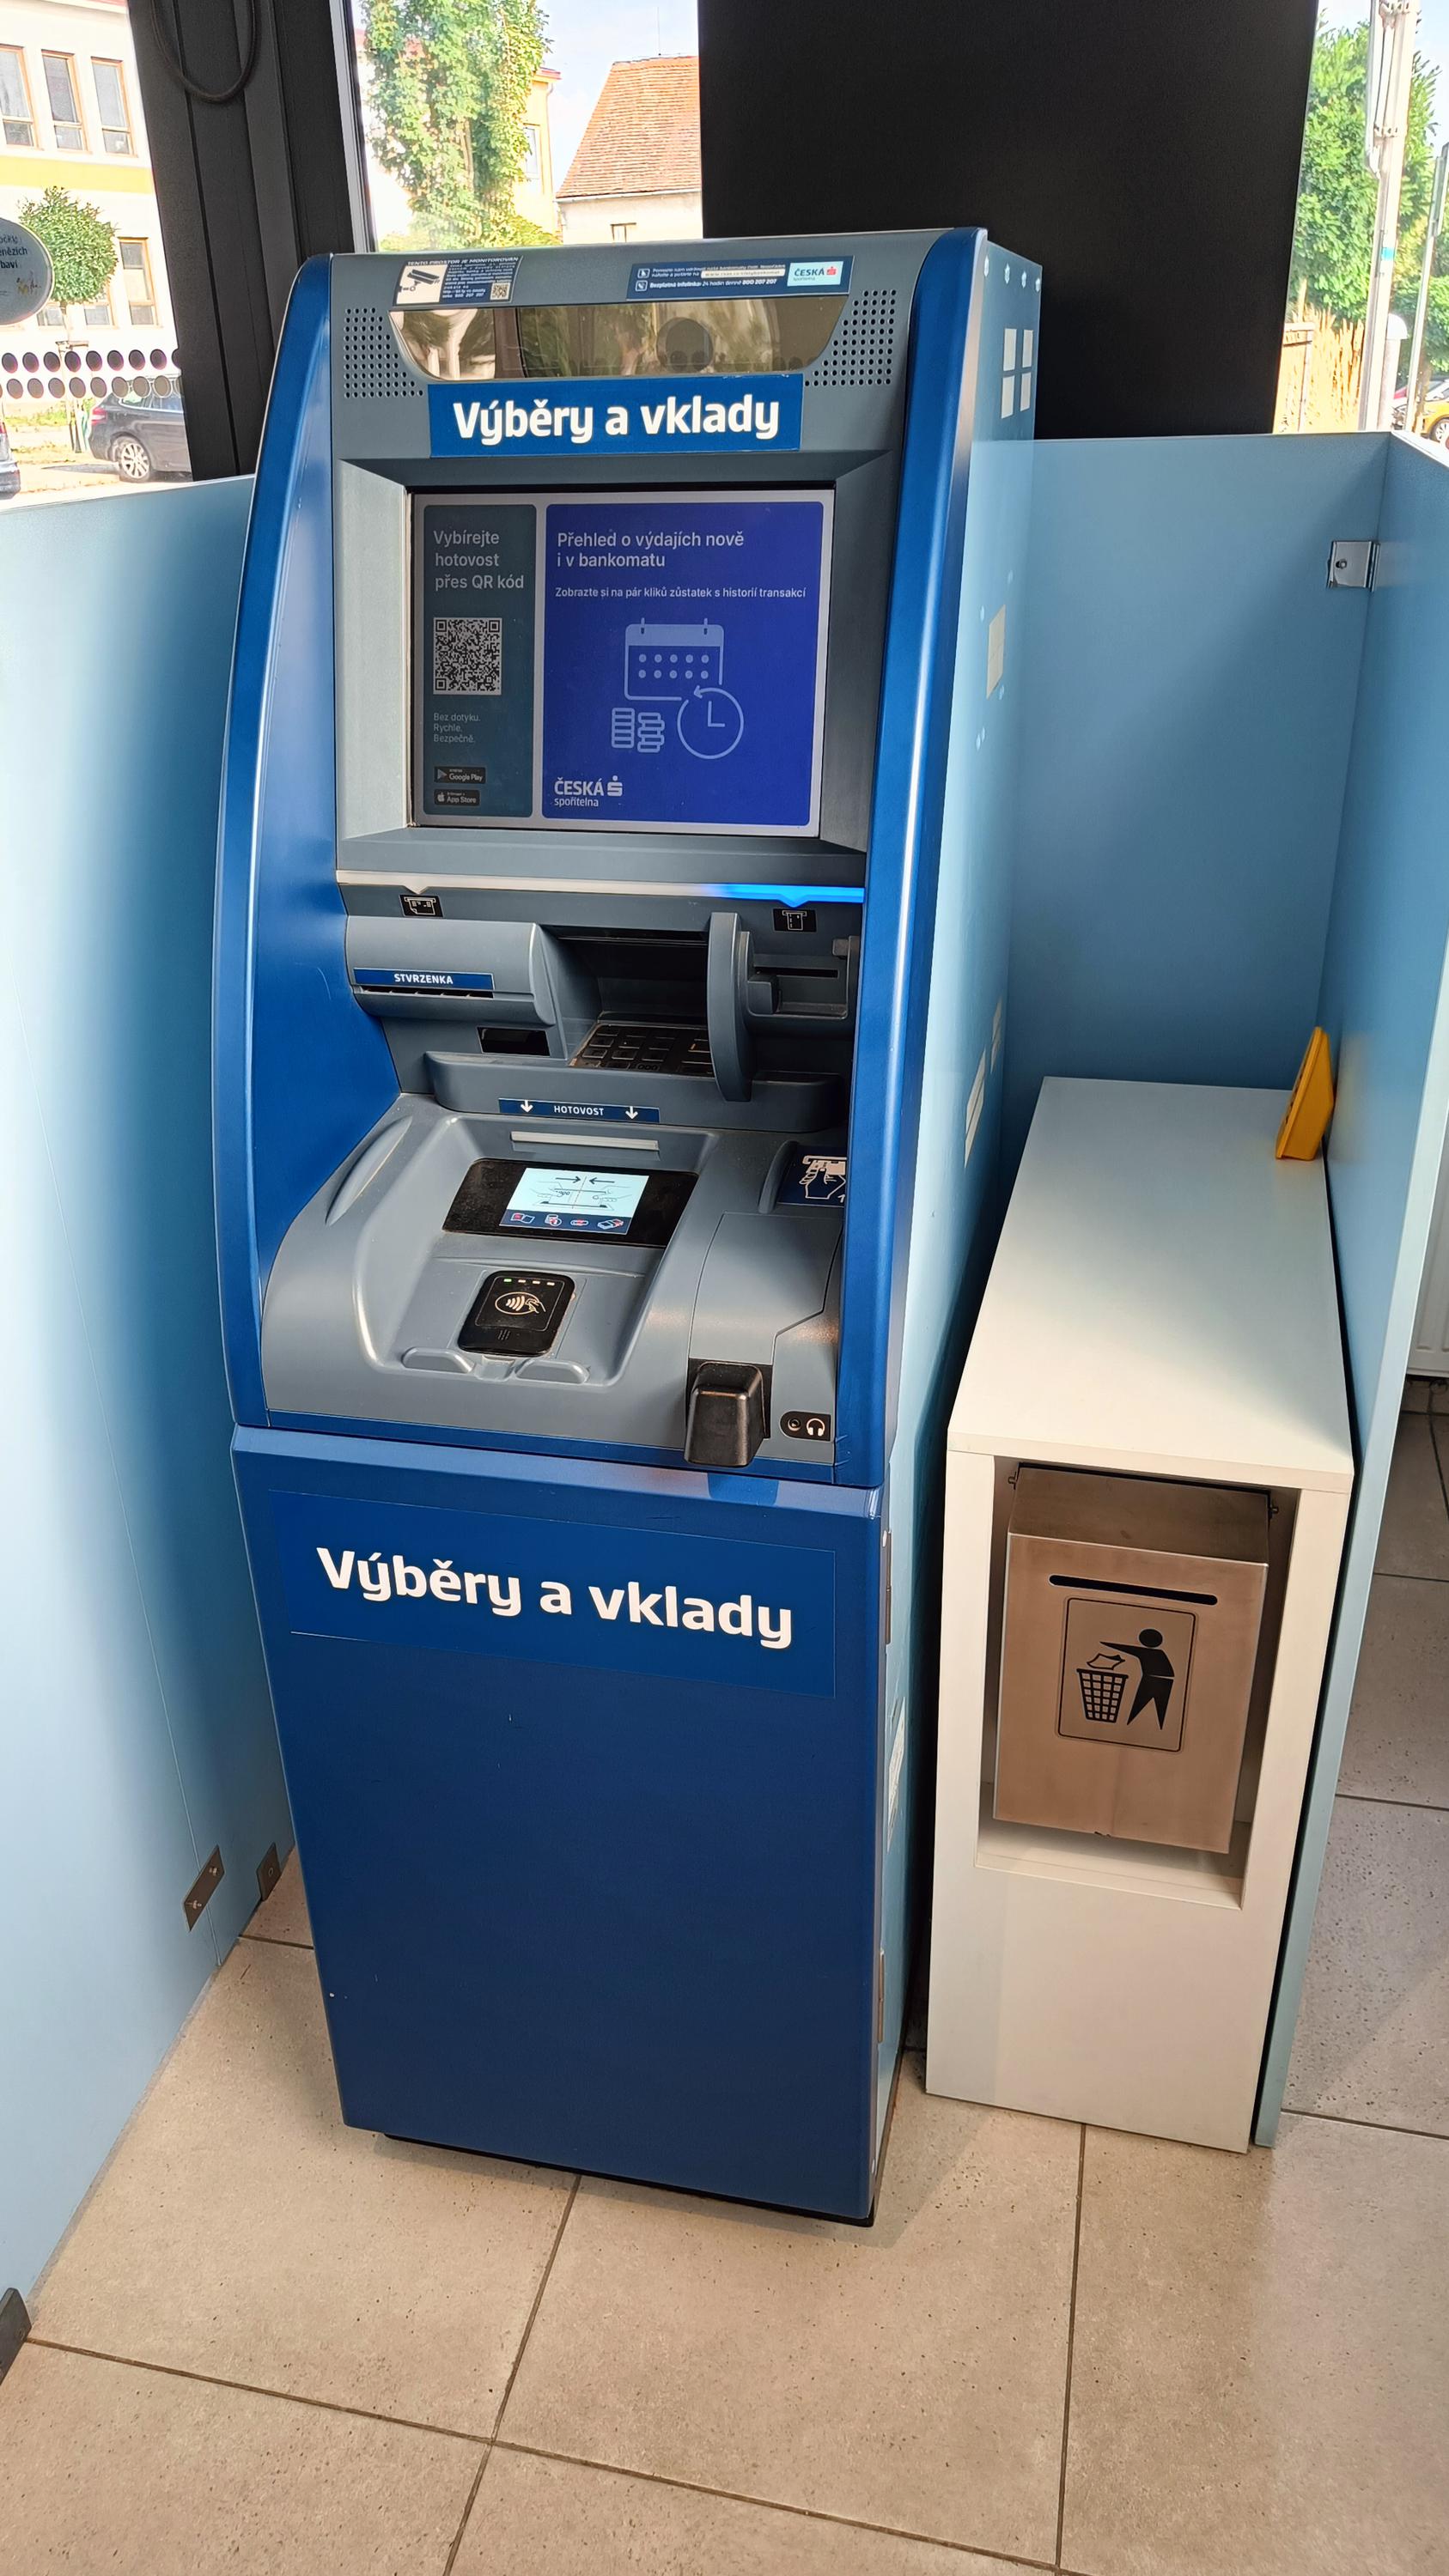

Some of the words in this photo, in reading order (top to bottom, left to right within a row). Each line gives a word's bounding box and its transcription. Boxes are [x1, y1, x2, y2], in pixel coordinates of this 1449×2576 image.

[794, 267, 825, 276] ČESKÁ
[453, 398, 593, 446] Výběry
[605, 406, 628, 435] a
[640, 394, 779, 440] vklady
[433, 529, 500, 548] Vybírejte
[557, 532, 617, 547] Přehled
[621, 535, 631, 547] o
[636, 531, 701, 550] výdajích
[706, 531, 744, 546] nově
[435, 552, 499, 567] hotovost
[557, 553, 561, 567] i
[565, 556, 575, 567] v
[579, 552, 666, 568] bankomatu
[435, 574, 468, 592] přes
[472, 574, 494, 589] QR
[498, 574, 524, 588] kód
[555, 587, 599, 597] Zobrazte
[600, 587, 609, 598] si
[625, 586, 642, 598] pár
[644, 586, 667, 597] kliků
[670, 586, 712, 597] zůstatek
[722, 587, 758, 597] historií
[759, 586, 807, 597] transakcí
[434, 713, 448, 721] Bez
[451, 713, 481, 723] dotyku.
[434, 723, 463, 732] Rychle.
[449, 773, 470, 781] Google
[554, 776, 605, 796] ČESKÁ
[554, 797, 599, 807] spořitelna
[393, 973, 454, 985] STVRZENKA
[553, 1105, 605, 1115] HOTOVOST
[315, 1546, 522, 1617] Výběry
[539, 1580, 572, 1615] a
[588, 1582, 792, 1649] vklady
